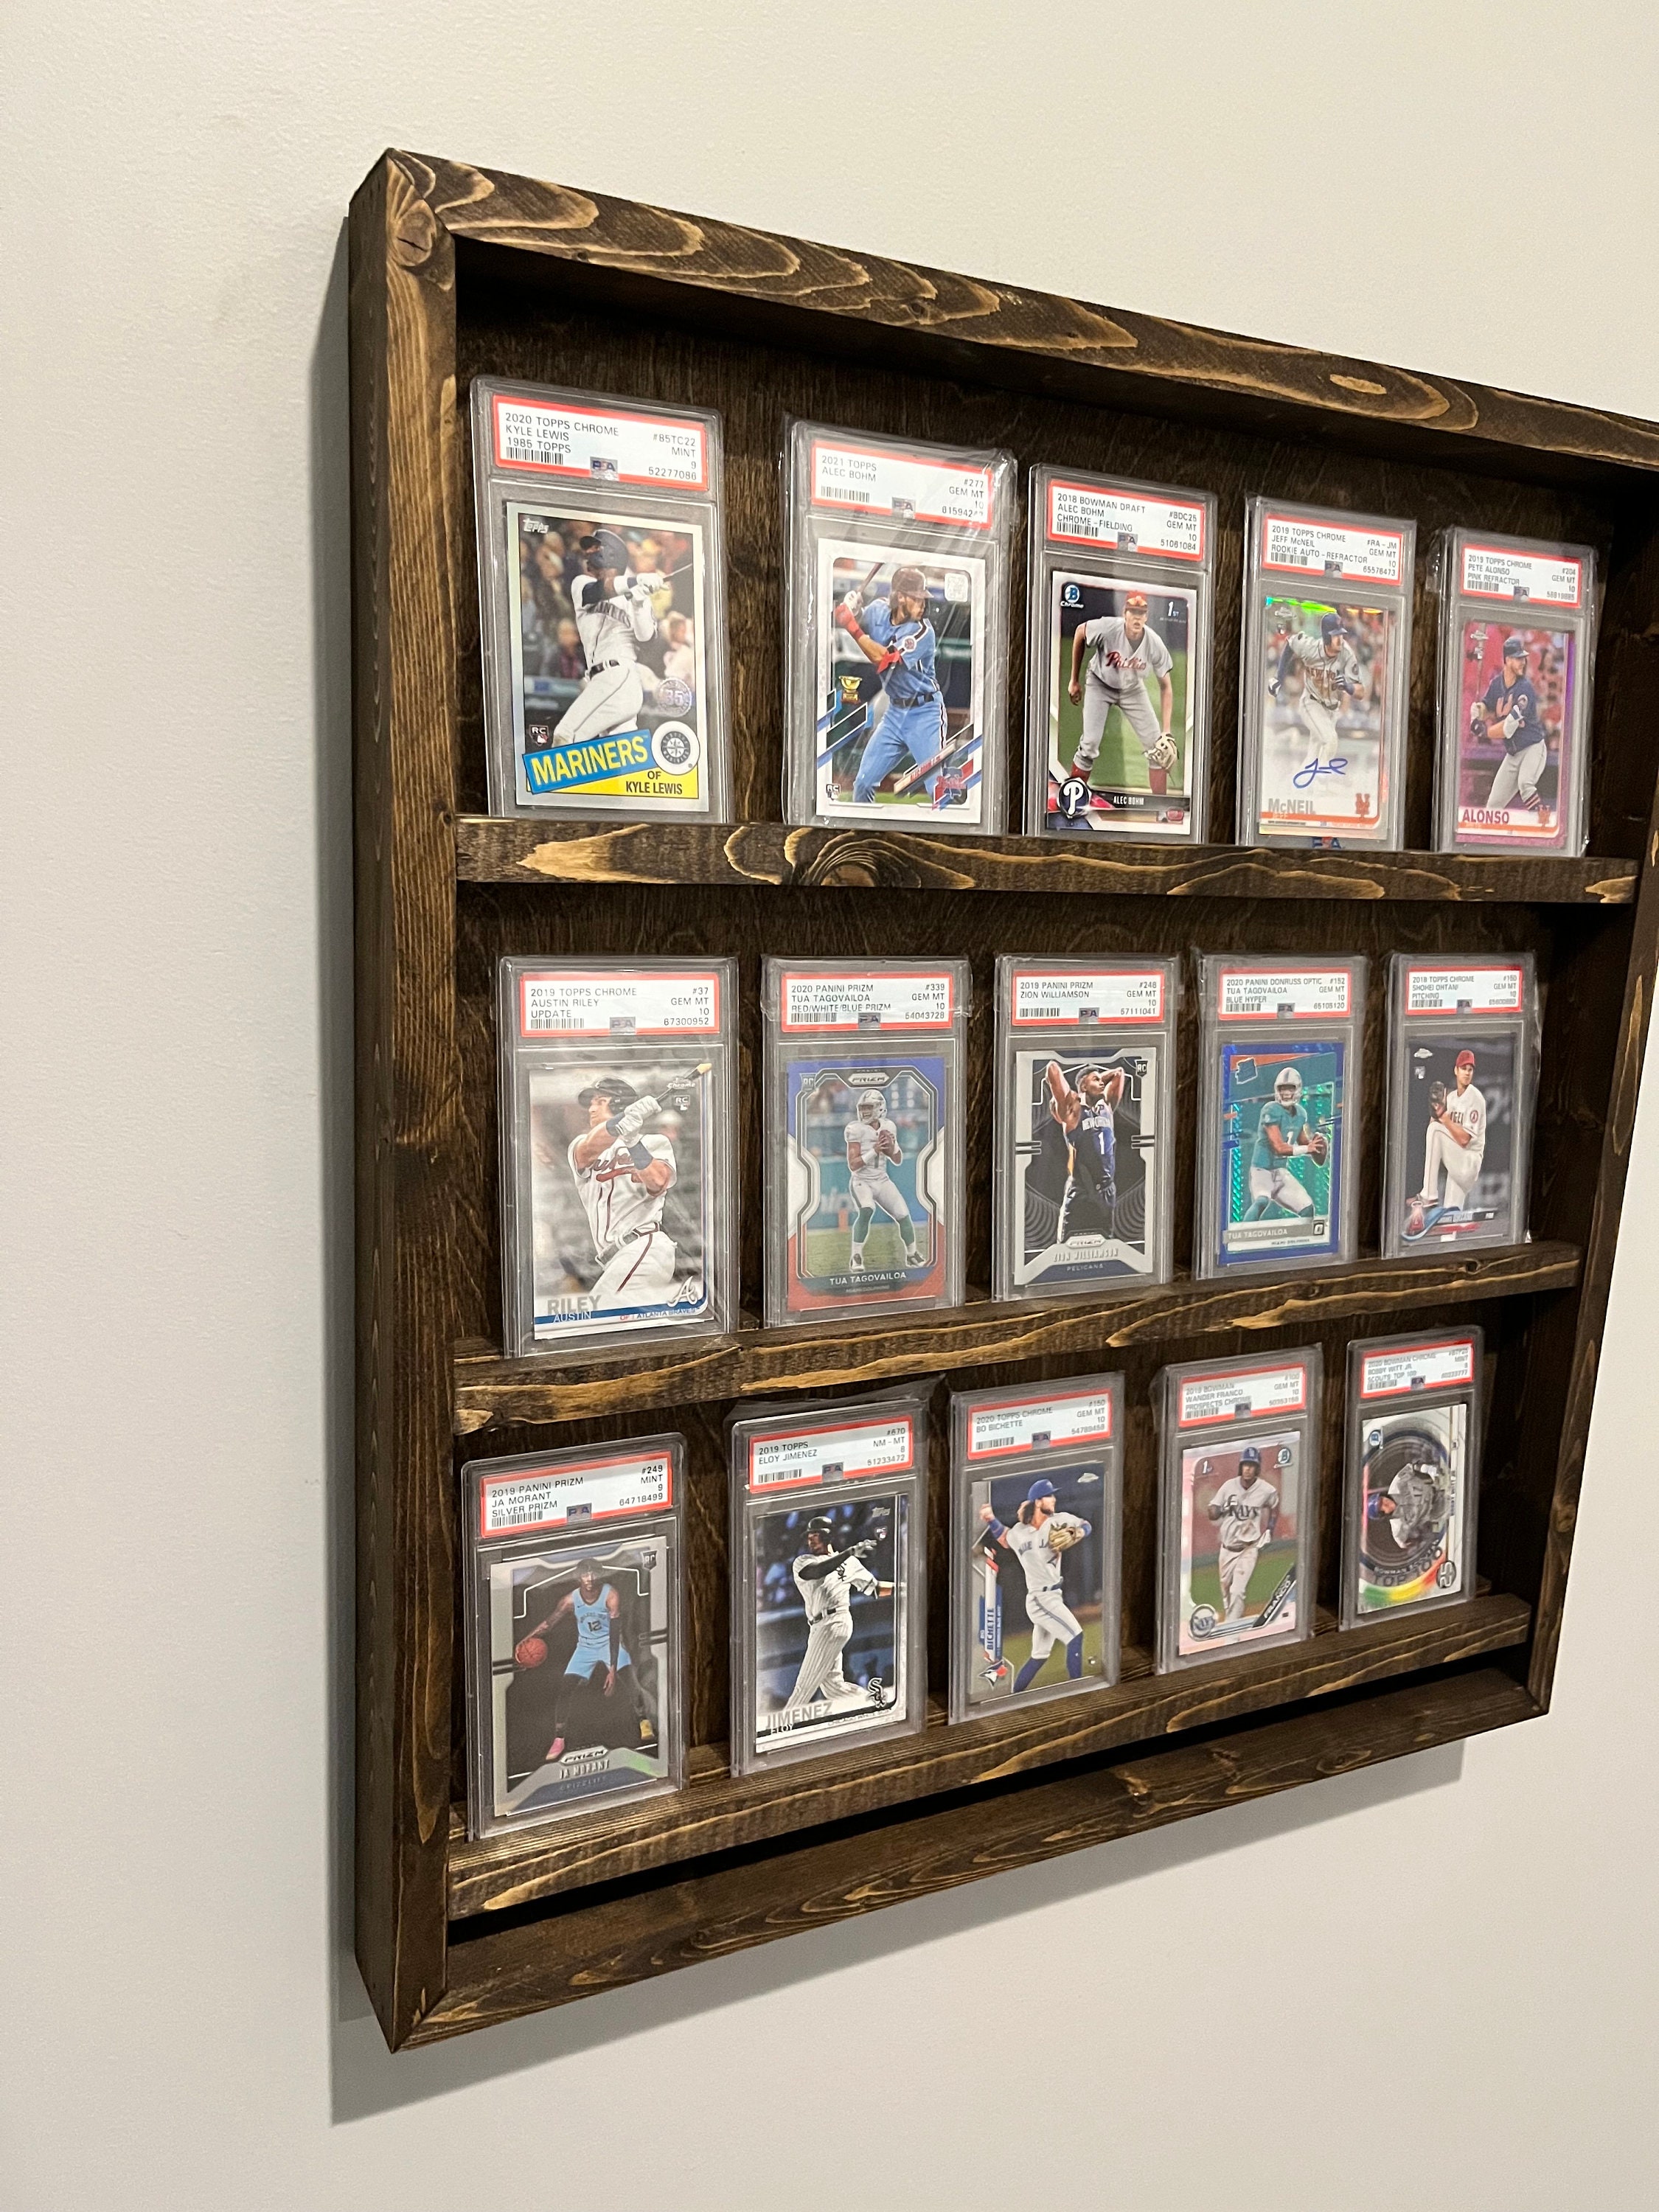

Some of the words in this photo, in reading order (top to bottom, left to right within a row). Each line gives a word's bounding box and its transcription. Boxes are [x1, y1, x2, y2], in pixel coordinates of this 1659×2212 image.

[506, 412, 532, 424] 2020
[537, 417, 570, 429] TOPPS
[574, 422, 619, 436] CHROME
[506, 425, 532, 436] KYLE
[537, 430, 569, 441] LEWIS
[508, 437, 532, 448] 1985
[537, 441, 571, 453] TOPPS
[653, 434, 695, 446] #85TC22
[672, 447, 695, 457] MINT
[821, 456, 844, 466] 2021
[849, 459, 877, 471] TOPPS
[822, 467, 845, 476] ALEC
[849, 470, 876, 481] BOHM
[964, 479, 984, 488] #277
[949, 487, 967, 496] GEM
[971, 490, 984, 498] MT
[1058, 493, 1077, 503] 2018
[1080, 496, 1117, 509] BOWMAN
[1121, 503, 1145, 513] DRAFT
[1058, 504, 1078, 513] ALEC
[1081, 507, 1104, 517] BOHM
[1057, 514, 1091, 525] CHROME
[1099, 520, 1133, 532] FIELDING
[1166, 521, 1183, 529] GEM
[1186, 523, 1197, 531] MT
[1272, 526, 1289, 534] 2019
[1293, 528, 1314, 538] TOPPS
[1317, 532, 1346, 542] CHROME
[1272, 535, 1287, 543] JEFF
[1291, 538, 1315, 547] McNEIL
[1272, 544, 1297, 554] ROOKIE
[1300, 548, 1319, 557] AUTO
[1327, 552, 1367, 563] REFRACTOR
[1469, 554, 1484, 563] 2019
[1486, 557, 1505, 566] TOPPS
[1507, 560, 1531, 569] CHROME
[1486, 567, 1509, 575] ALONSO
[1484, 574, 1520, 585] REFRACTOR
[531, 737, 648, 785] MARINERS
[647, 770, 661, 779] OF
[626, 782, 650, 793] KYLE
[653, 783, 682, 794] LEWIS
[1113, 796, 1127, 804] ALEC
[1268, 798, 1315, 815] McNEIL
[1463, 809, 1509, 824] ALONSO
[531, 989, 554, 997] 2019
[531, 999, 568, 1007] AUSTIN
[1244, 1228, 1287, 1238] TAGOVAILOA
[1074, 1248, 1118, 1260] WILLIAMSON
[1067, 1263, 1103, 1271] PELICANS
[830, 1276, 847, 1285] TUA
[850, 1272, 906, 1284] TAGOVAILOA
[548, 1294, 602, 1315] RILEY
[552, 1310, 592, 1324] AUSTIN
[1186, 1394, 1214, 1402] WANDER
[1217, 1389, 1242, 1398] FRANCO
[1186, 1401, 1222, 1410] PROSPECTS
[977, 1416, 995, 1424] 2020
[997, 1412, 1020, 1420] TOPPS
[1022, 1407, 1053, 1417] CHROME
[989, 1420, 1023, 1430] BICHETTE
[759, 1445, 779, 1455] 2019
[783, 1441, 808, 1451] TOPPS
[873, 1439, 886, 1447] NM
[894, 1436, 905, 1444] MT
[759, 1455, 779, 1464] ELOY
[783, 1449, 817, 1461] JIMENEZ
[642, 1465, 663, 1474] #249
[641, 1474, 663, 1484] MINT
[492, 1487, 515, 1498] 2019
[519, 1482, 552, 1494] PANINI
[555, 1477, 583, 1488] PRIZM
[492, 1499, 504, 1508] JA
[509, 1492, 551, 1505] MORANT
[492, 1506, 525, 1517] SILVER
[529, 1500, 557, 1512] PRIZM
[765, 1701, 832, 1728] JIMENEZ
[564, 1750, 604, 1761] PRIZM
[572, 1759, 609, 1777] MORANT
